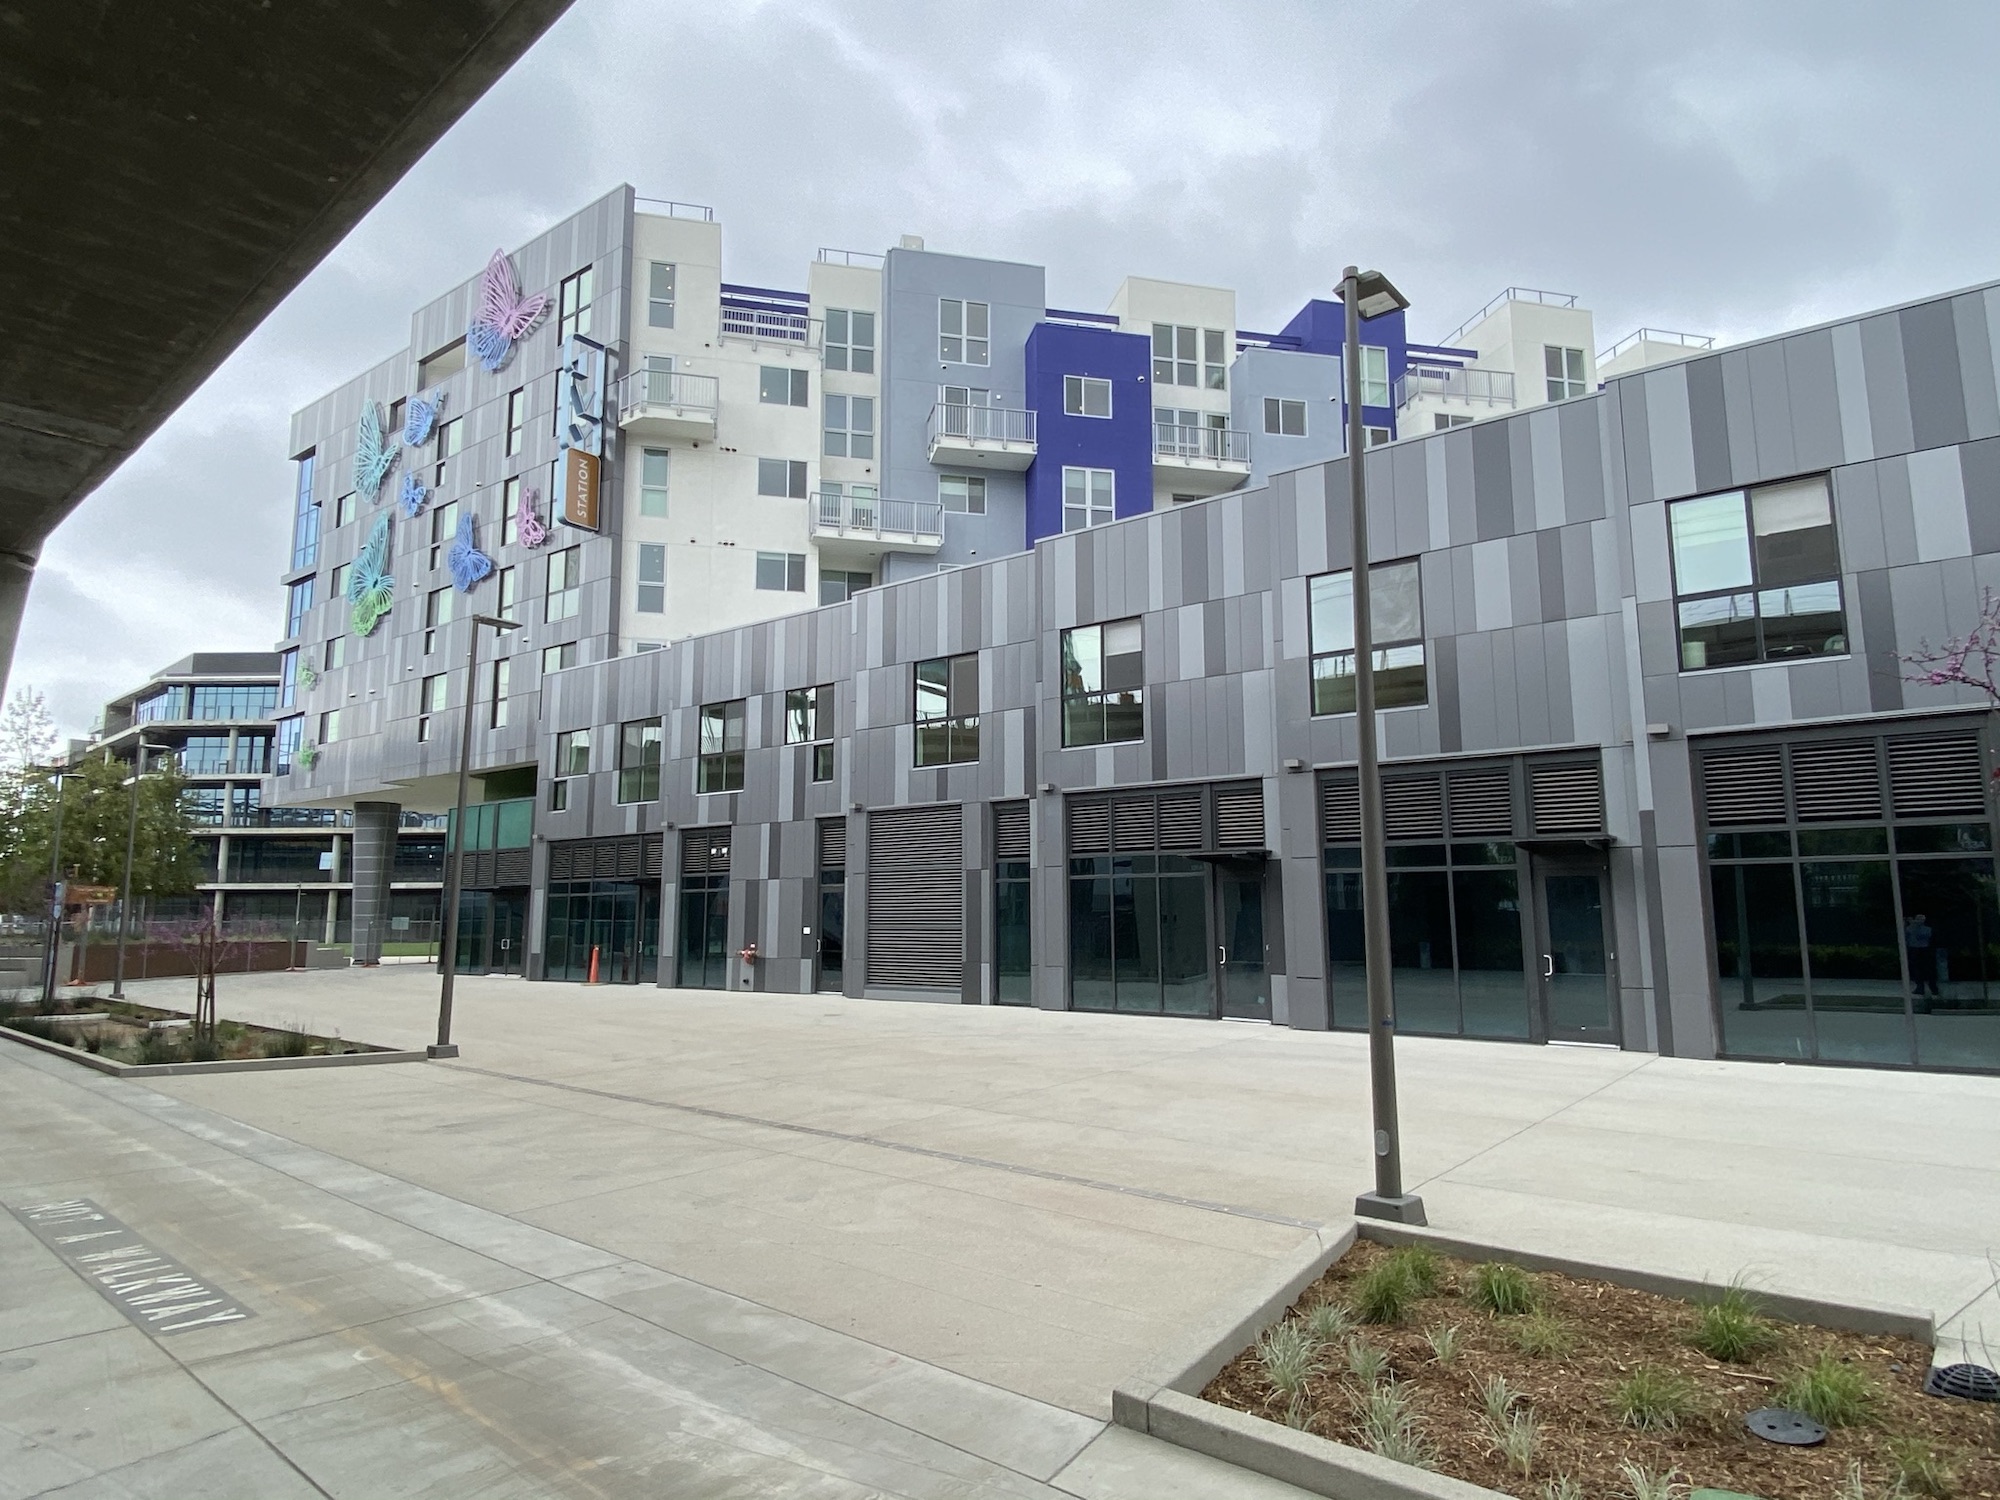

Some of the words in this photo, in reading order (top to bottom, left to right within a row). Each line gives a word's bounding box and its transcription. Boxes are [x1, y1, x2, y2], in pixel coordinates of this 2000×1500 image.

[576, 458, 589, 519] STATION
[54, 1229, 123, 1245] A
[76, 1244, 247, 1332] WALKWAY
